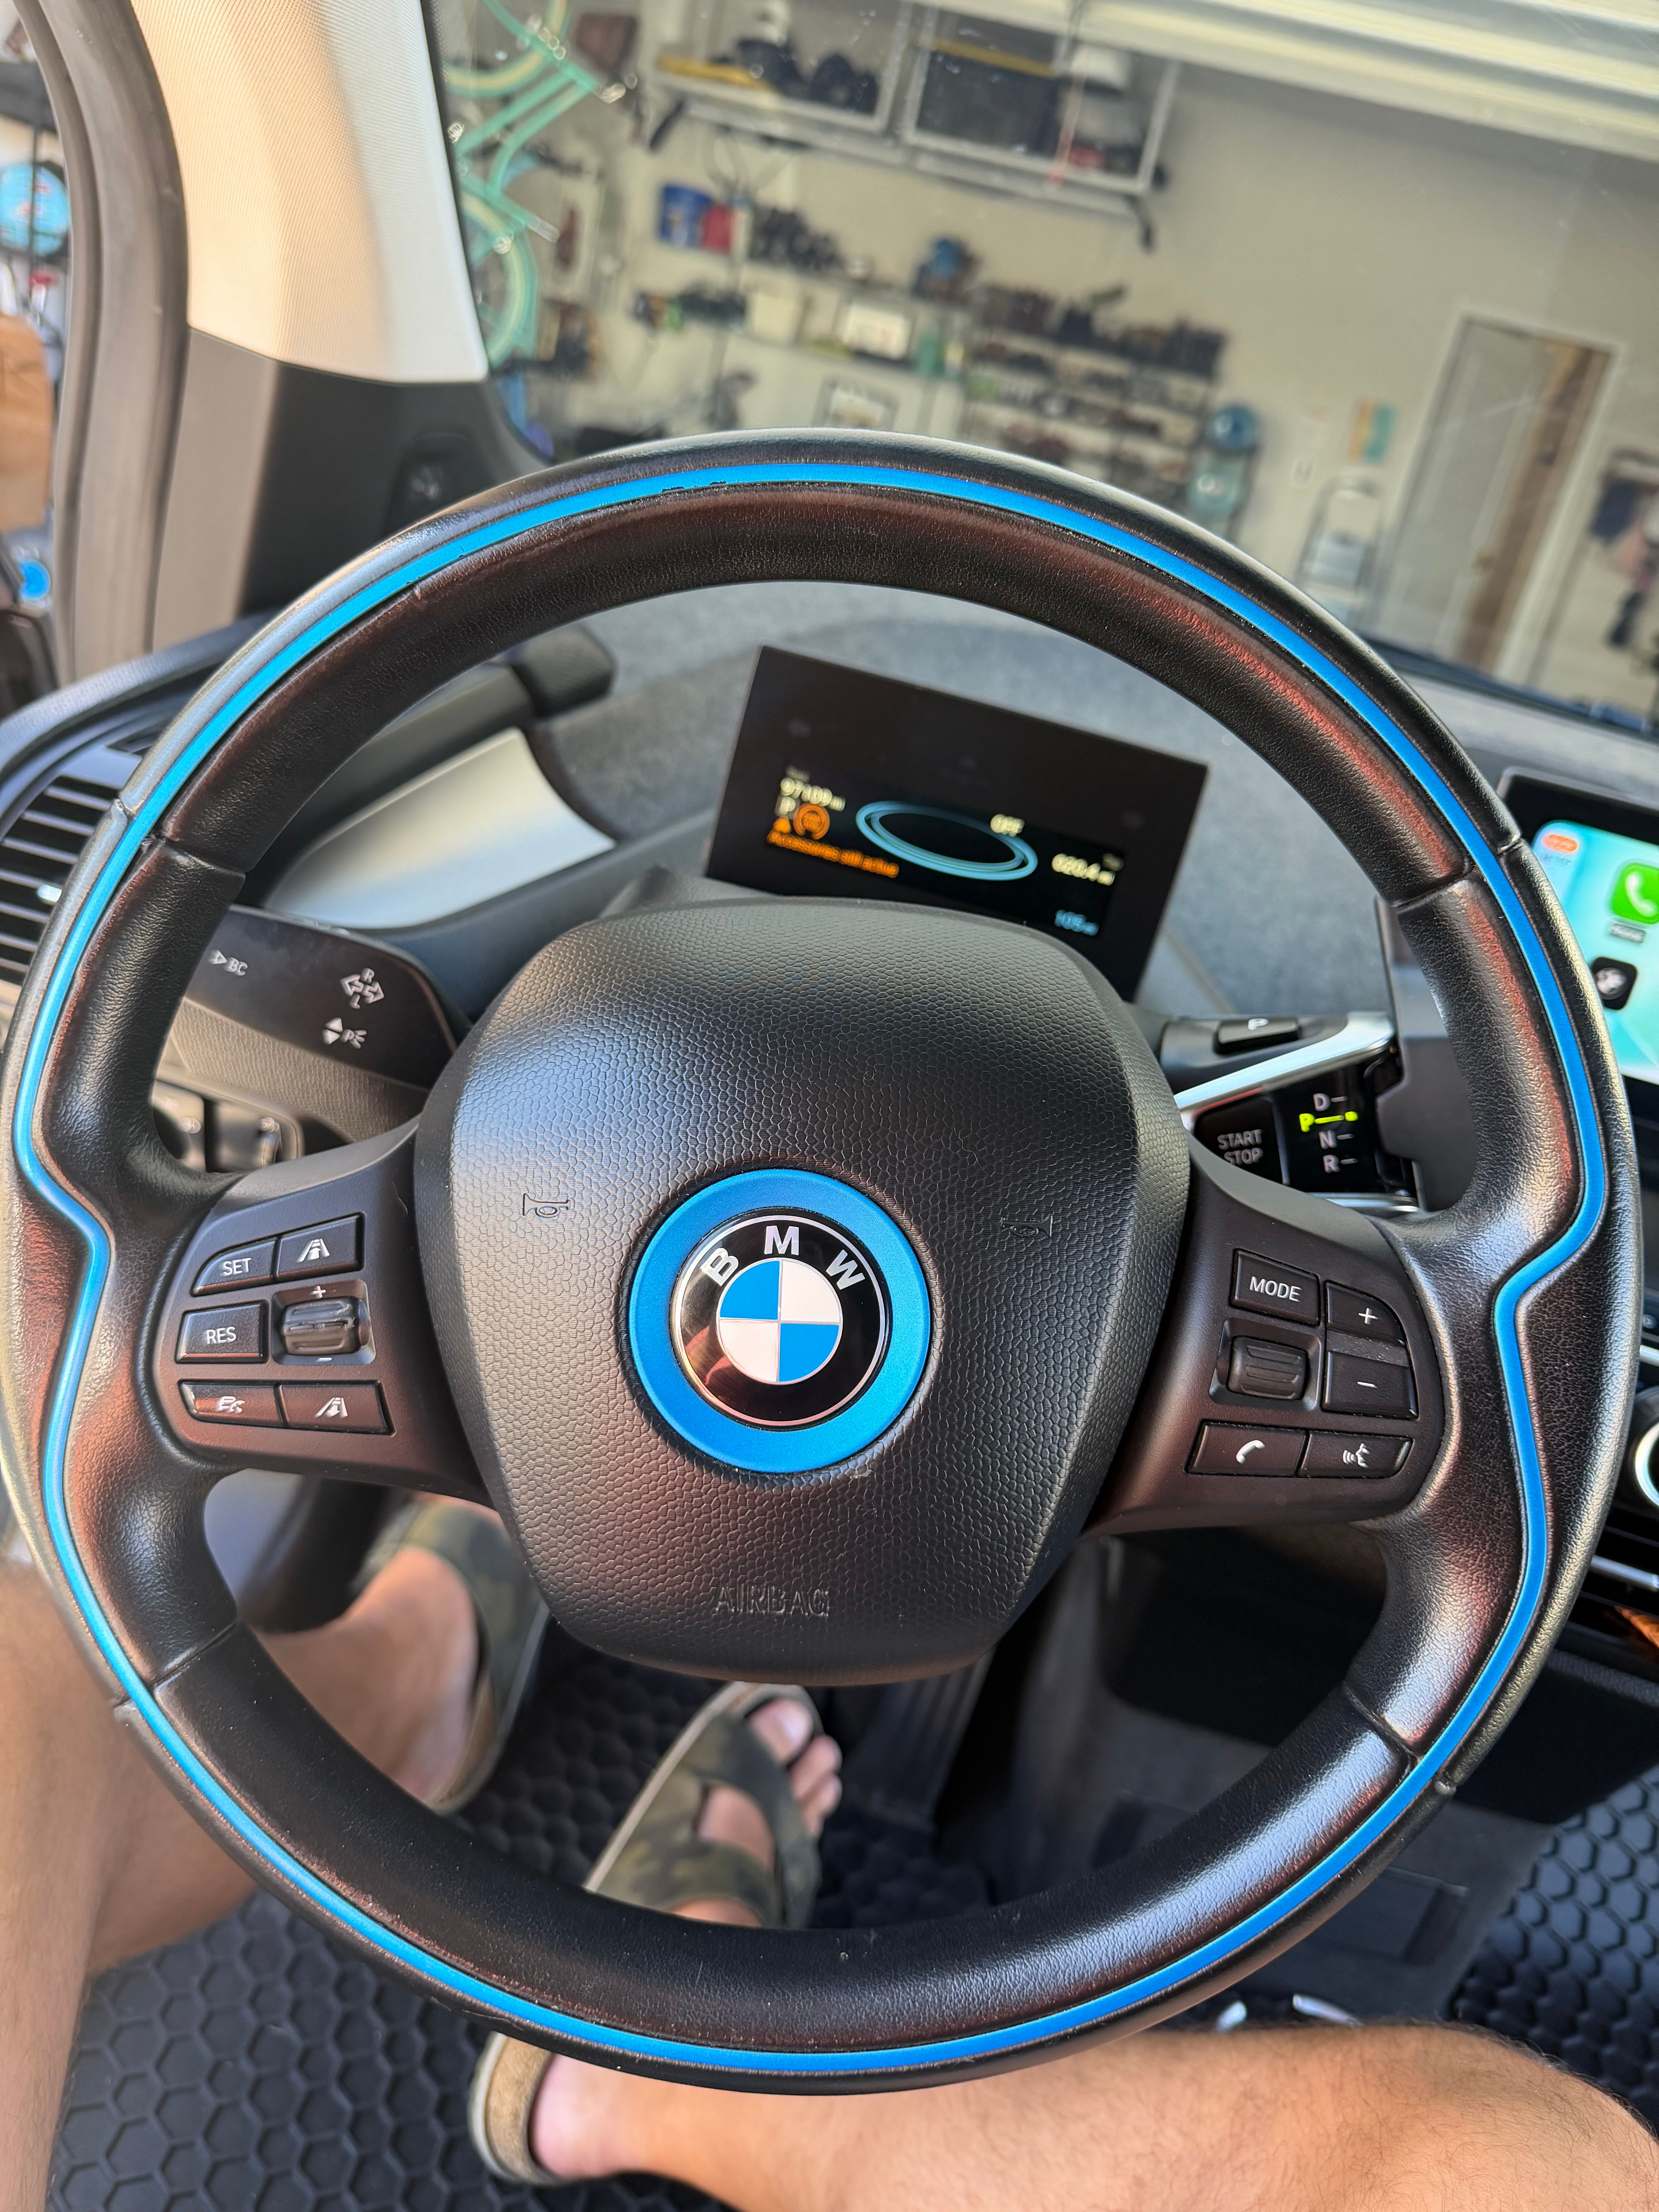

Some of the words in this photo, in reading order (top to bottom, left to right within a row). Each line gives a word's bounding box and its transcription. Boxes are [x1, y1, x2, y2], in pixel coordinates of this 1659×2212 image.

[1248, 1018, 1269, 1030] P
[1313, 1093, 1331, 1112] D
[1299, 1113, 1315, 1132] P
[1217, 1128, 1263, 1150] START
[1319, 1130, 1338, 1149] N
[1223, 1147, 1264, 1166] STOP
[1323, 1154, 1341, 1174] R
[222, 1257, 252, 1276] SET
[700, 1225, 866, 1290] BMW
[1249, 1276, 1302, 1302] MODE
[205, 1326, 237, 1345] RES
[715, 1584, 830, 1617] AIRBAG
